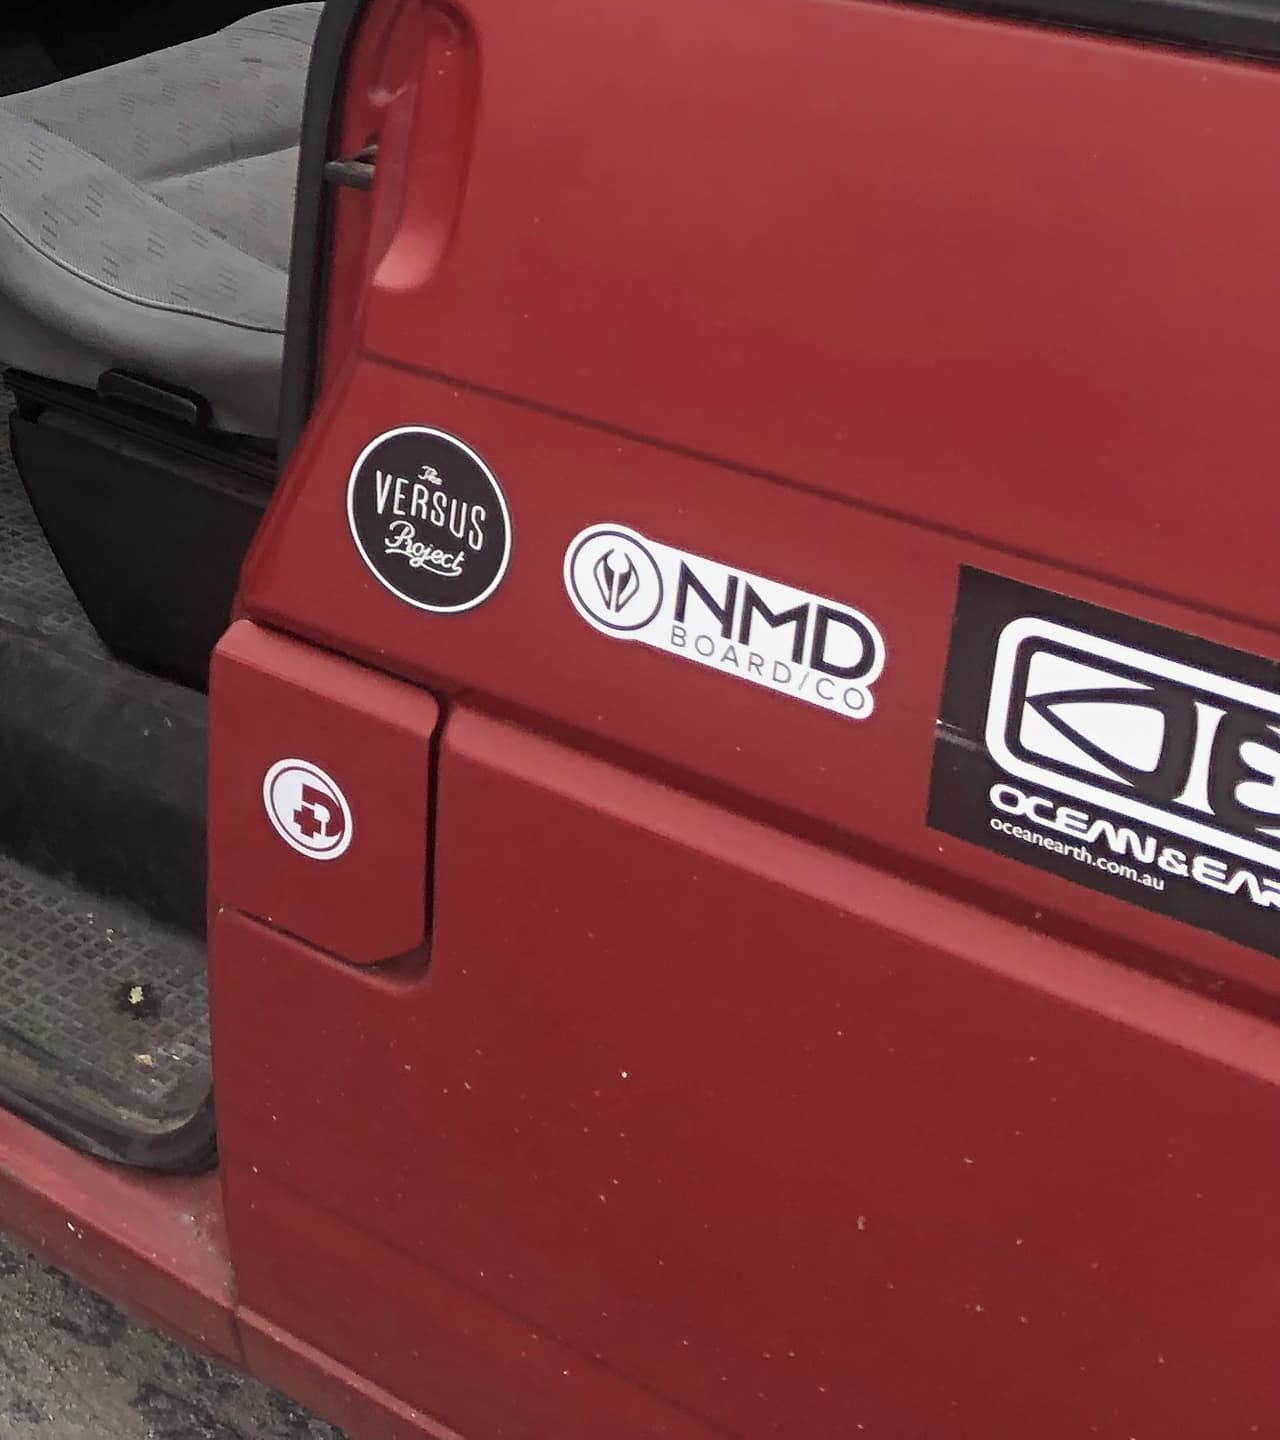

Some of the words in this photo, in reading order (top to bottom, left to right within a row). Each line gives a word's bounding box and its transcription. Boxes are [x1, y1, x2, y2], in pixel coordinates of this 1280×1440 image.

[376, 470, 487, 551] VERSUS
[384, 520, 465, 577] Project
[673, 559, 876, 680] NMD
[670, 625, 865, 710] BOARD/CO
[989, 817, 1166, 891] oceanearth.com.au
